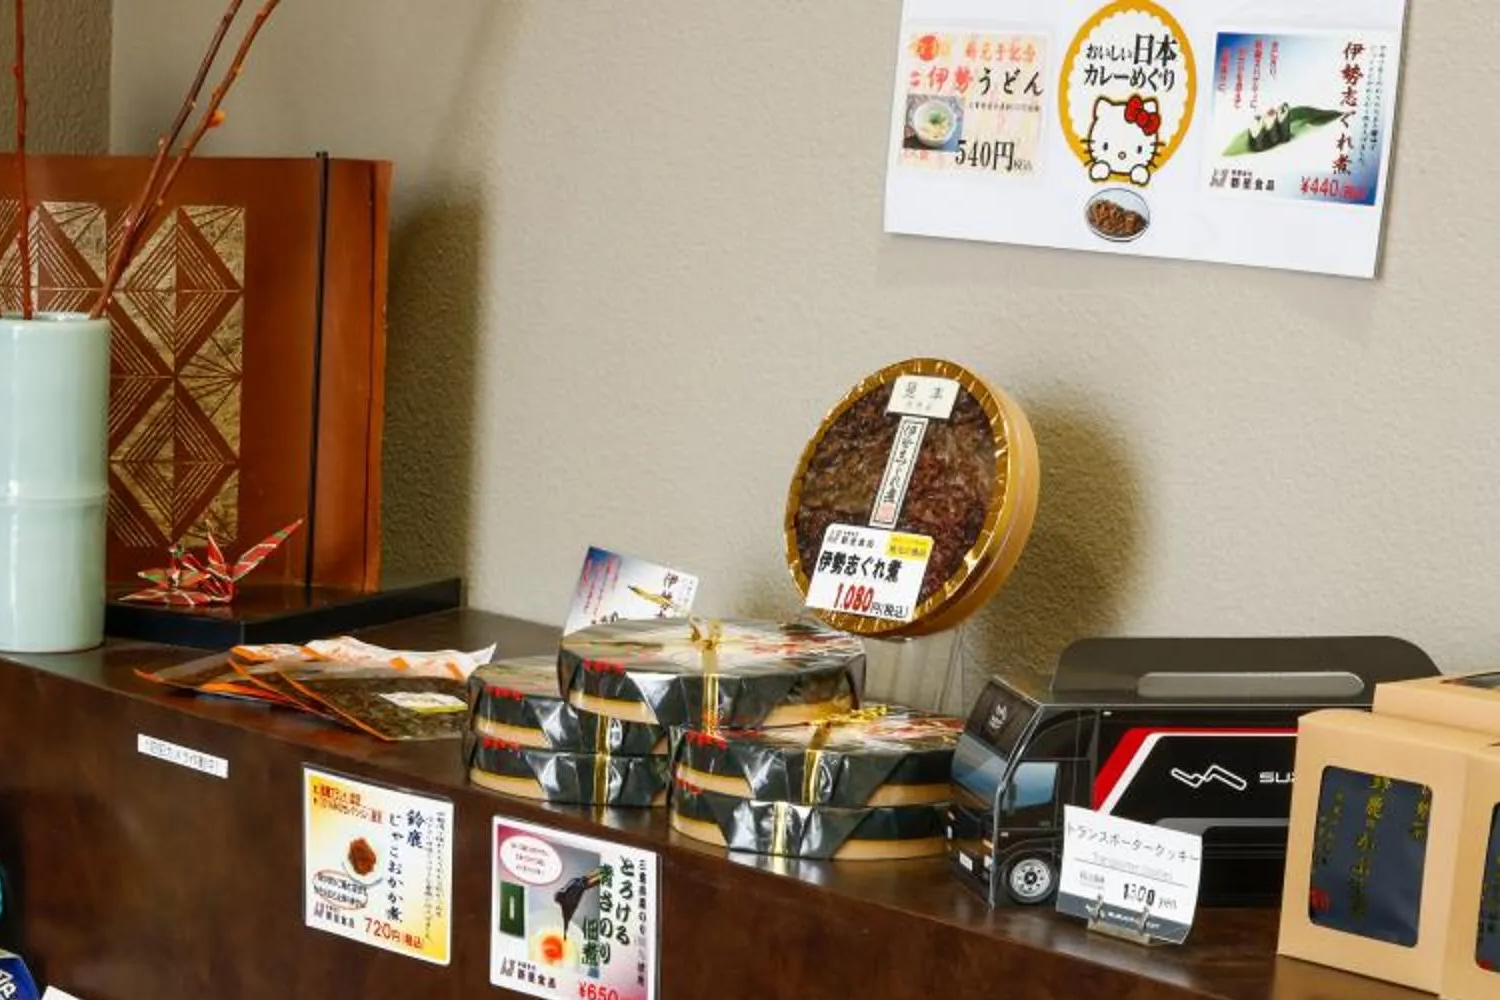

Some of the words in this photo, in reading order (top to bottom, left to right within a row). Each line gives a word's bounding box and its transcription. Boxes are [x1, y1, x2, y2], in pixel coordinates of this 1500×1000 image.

[1086, 33, 1178, 67] おいしい日本
[1084, 64, 1175, 92] カレーめぐり
[955, 138, 1016, 173] 540円
[817, 549, 903, 583] 伊勢志ぐれ煮
[1259, 771, 1292, 783] SU
[406, 809, 426, 850] 鈴鹿
